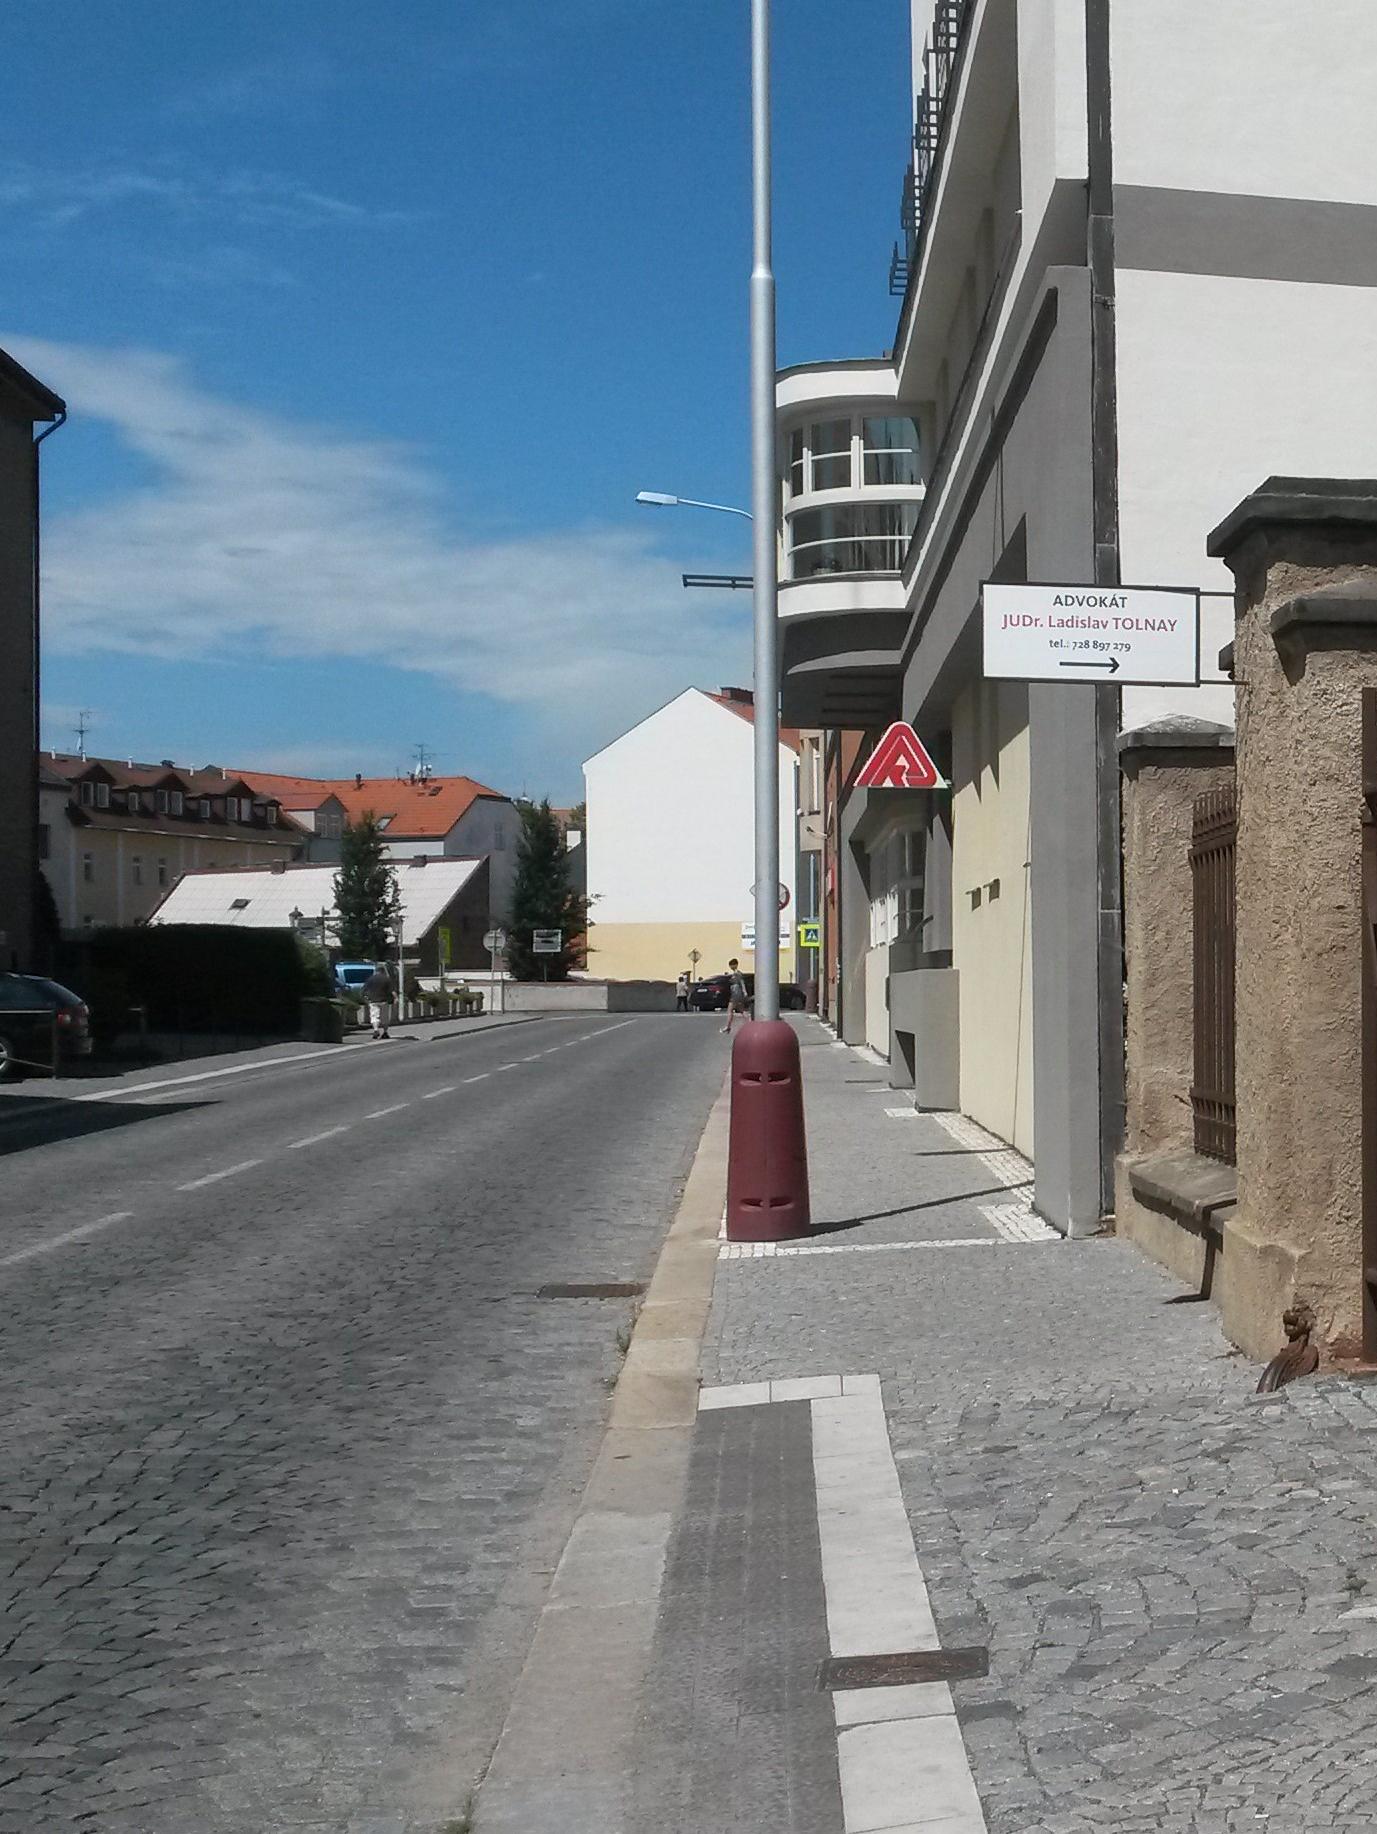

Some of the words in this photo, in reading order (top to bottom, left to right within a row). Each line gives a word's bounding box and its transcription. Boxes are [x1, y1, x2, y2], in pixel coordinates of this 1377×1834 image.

[1053, 594, 1128, 608] ADVOKÁT
[1001, 614, 1043, 630] JUDr.
[1048, 615, 1109, 630] Ladislav
[1112, 617, 1178, 632] TOLNAY
[1072, 639, 1090, 650] 728
[1092, 640, 1111, 651] 897
[1113, 642, 1131, 652] 279
